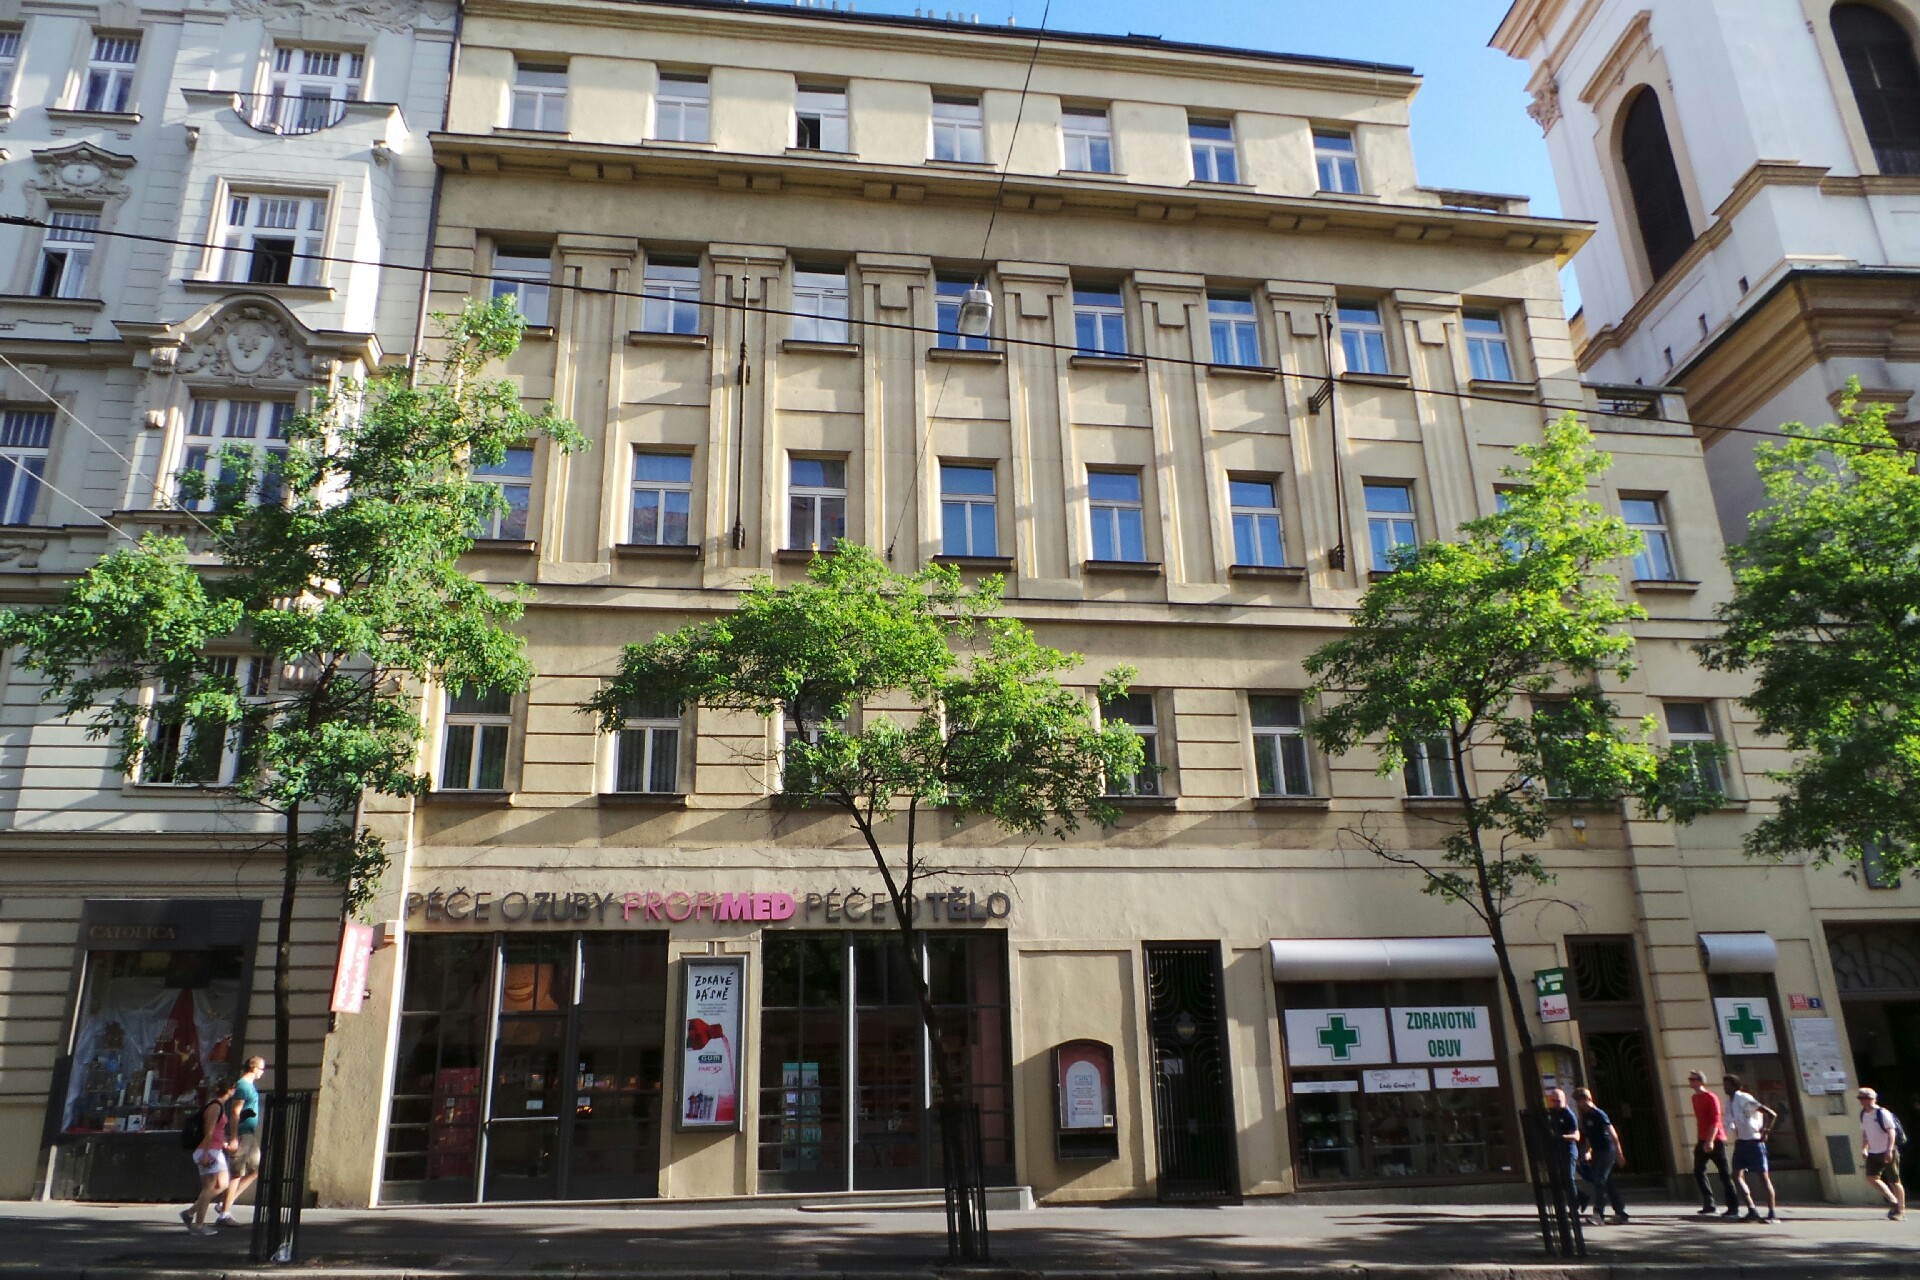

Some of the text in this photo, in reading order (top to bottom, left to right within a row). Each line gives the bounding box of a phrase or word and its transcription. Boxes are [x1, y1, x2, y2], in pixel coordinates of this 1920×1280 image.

[404, 886, 492, 922] PÉČE
[623, 891, 796, 921] PROFIMED
[805, 887, 886, 922] PÉČE
[926, 886, 1011, 922] TĚLO
[89, 925, 176, 940] CATOLICA
[694, 972, 735, 987] ZDRAVÉ
[695, 986, 730, 1002] DÁSNĚ
[1405, 1008, 1476, 1030] ZDRAVOTNÍ
[1427, 1039, 1462, 1057] OBUV
